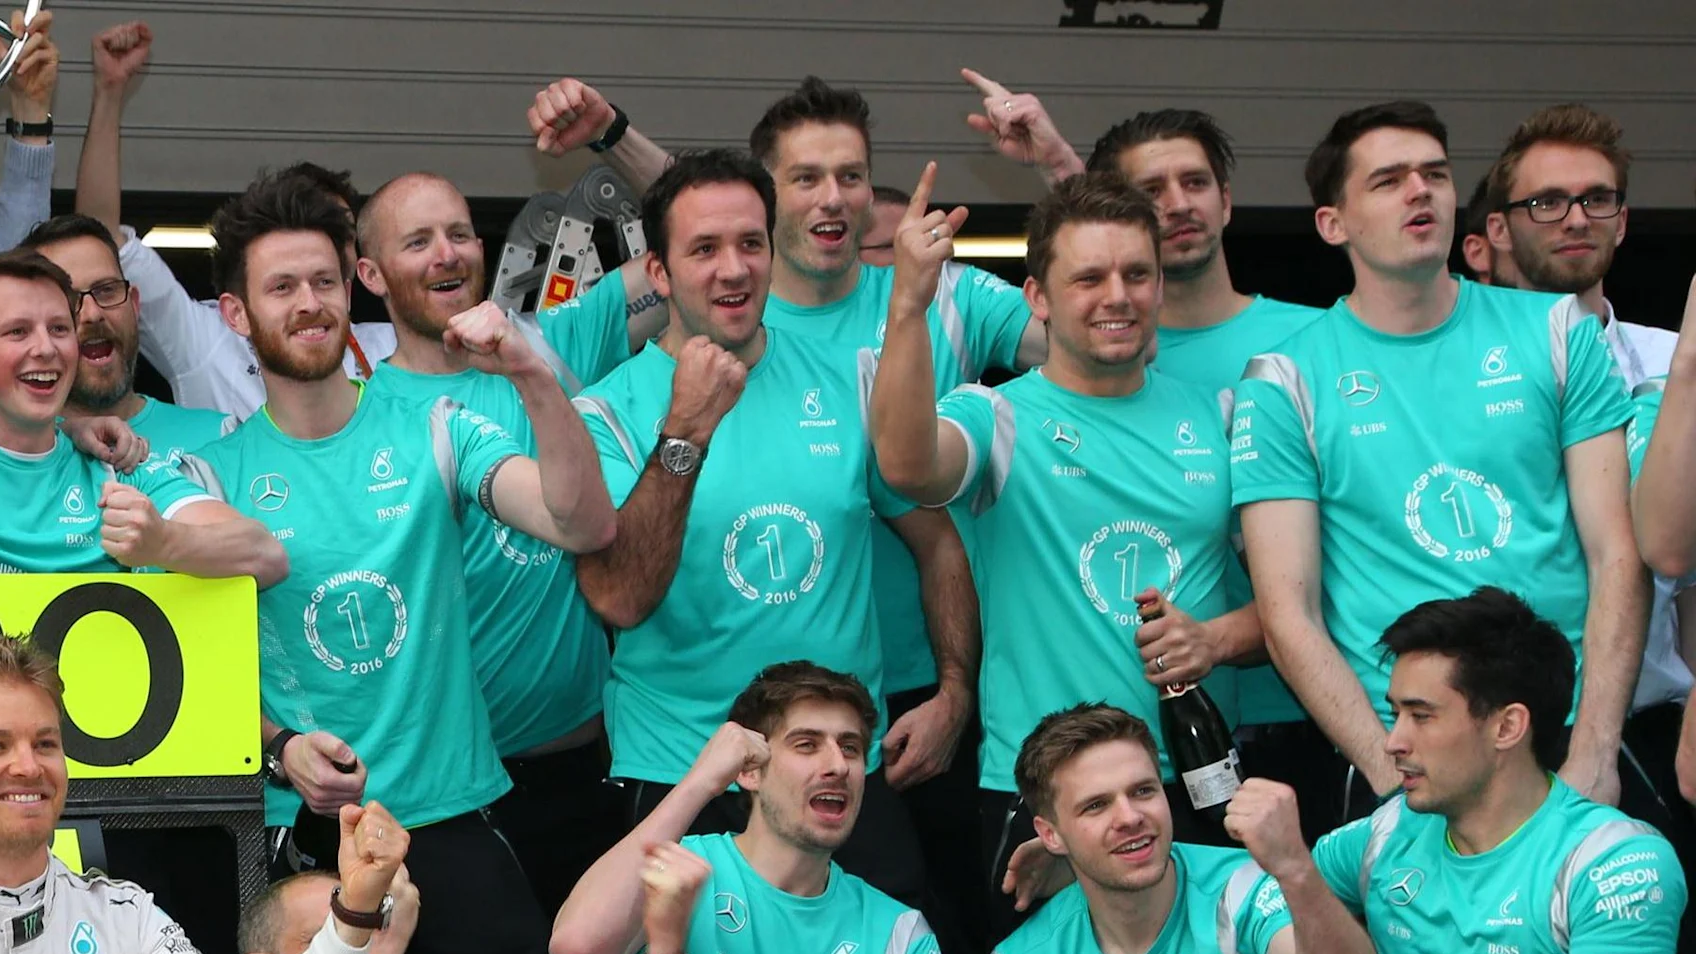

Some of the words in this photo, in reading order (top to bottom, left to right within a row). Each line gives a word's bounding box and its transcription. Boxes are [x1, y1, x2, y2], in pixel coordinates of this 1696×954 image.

[1477, 374, 1523, 388] PETRONAS
[1486, 400, 1524, 416] BOSS
[1362, 422, 1387, 434] UBS
[810, 444, 841, 454] BOSS
[1064, 467, 1087, 477] UBS
[368, 478, 408, 493] PETRONAS
[1413, 475, 1429, 491] GP
[376, 503, 410, 520] BOSS
[733, 515, 748, 533] GP
[748, 503, 807, 522] WINNERS
[1093, 529, 1111, 544] GP
[1112, 521, 1170, 549] WINNERS
[757, 525, 785, 580] 1
[1455, 546, 1491, 562] 2016
[311, 584, 328, 603] GP
[325, 570, 388, 589] WINNERS
[765, 592, 797, 605] 2016
[337, 591, 370, 650] 1
[350, 658, 384, 675] 2016
[1589, 851, 1659, 881] QUALCOMM
[1598, 868, 1659, 896] EPSON
